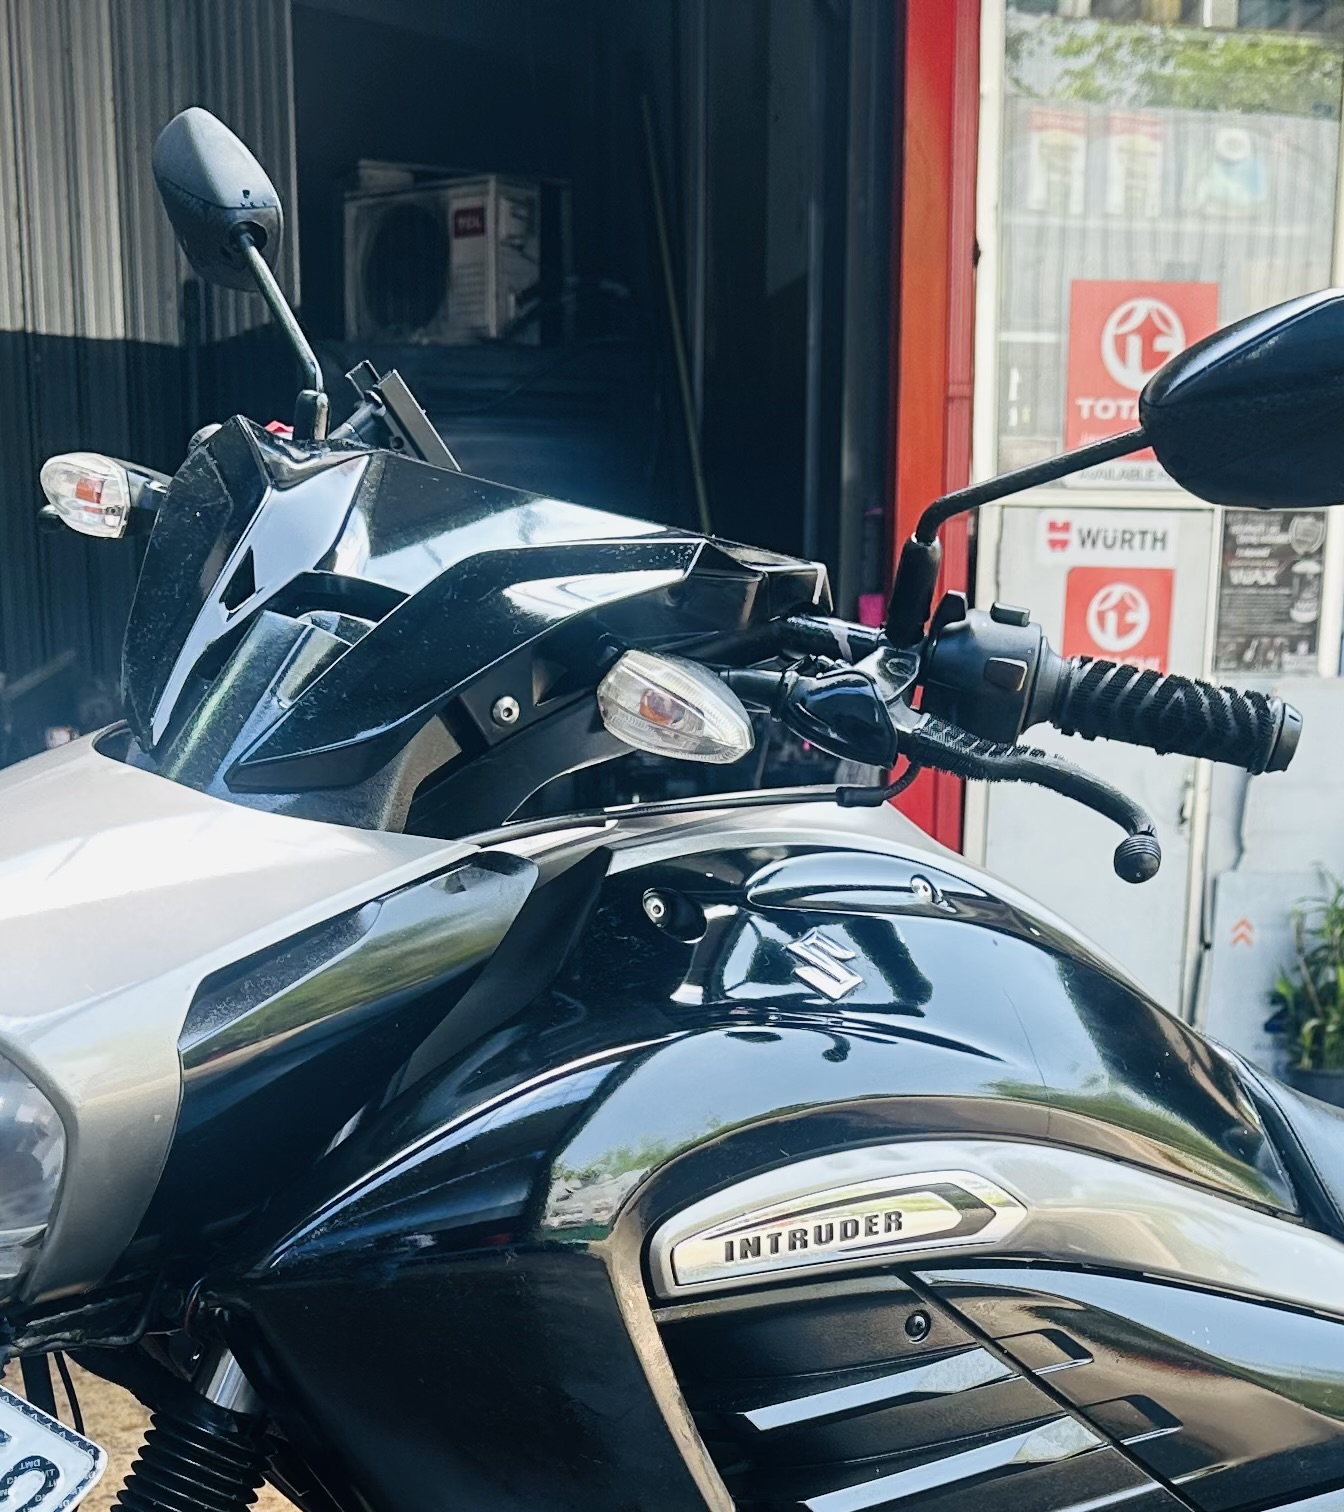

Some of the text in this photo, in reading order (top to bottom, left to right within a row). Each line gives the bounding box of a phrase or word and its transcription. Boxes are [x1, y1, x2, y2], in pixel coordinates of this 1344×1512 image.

[1075, 397, 1140, 421] TOT
[1078, 527, 1168, 551] WÜRTH
[723, 1210, 904, 1263] INTRUDER
